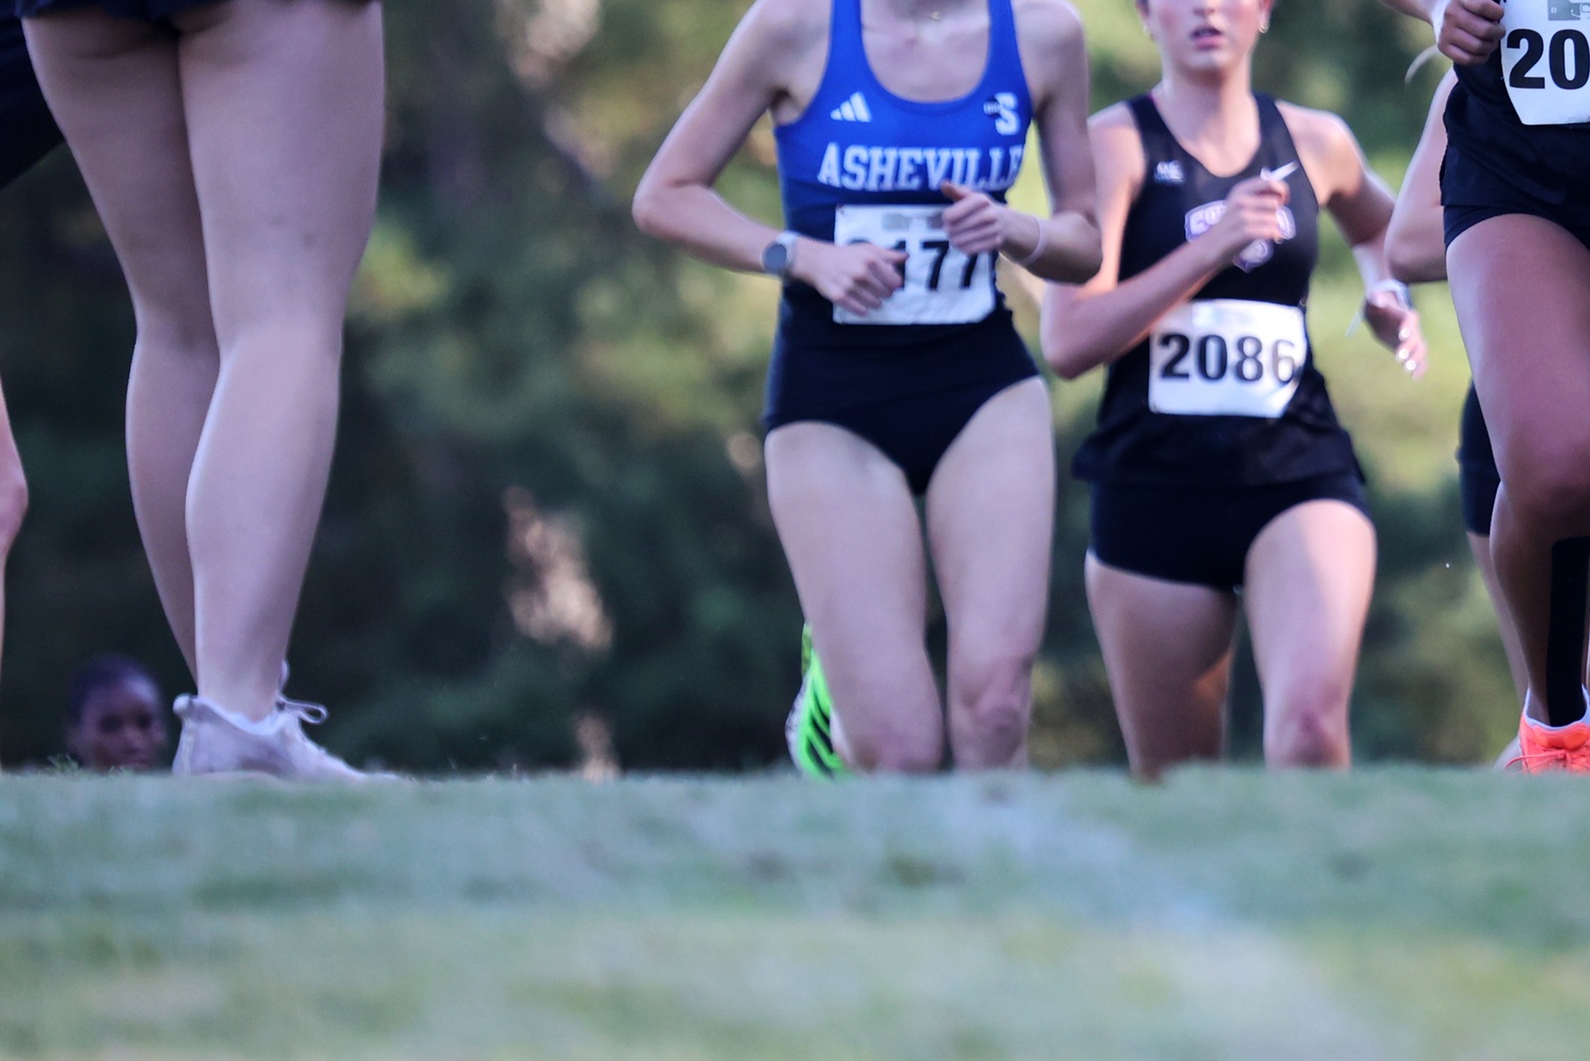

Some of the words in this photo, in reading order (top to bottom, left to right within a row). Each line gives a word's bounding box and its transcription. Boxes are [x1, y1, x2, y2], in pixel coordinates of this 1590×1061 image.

[818, 142, 1023, 192] ASHEVILLE
[848, 237, 979, 291] 177
[1158, 334, 1296, 384] 2086
